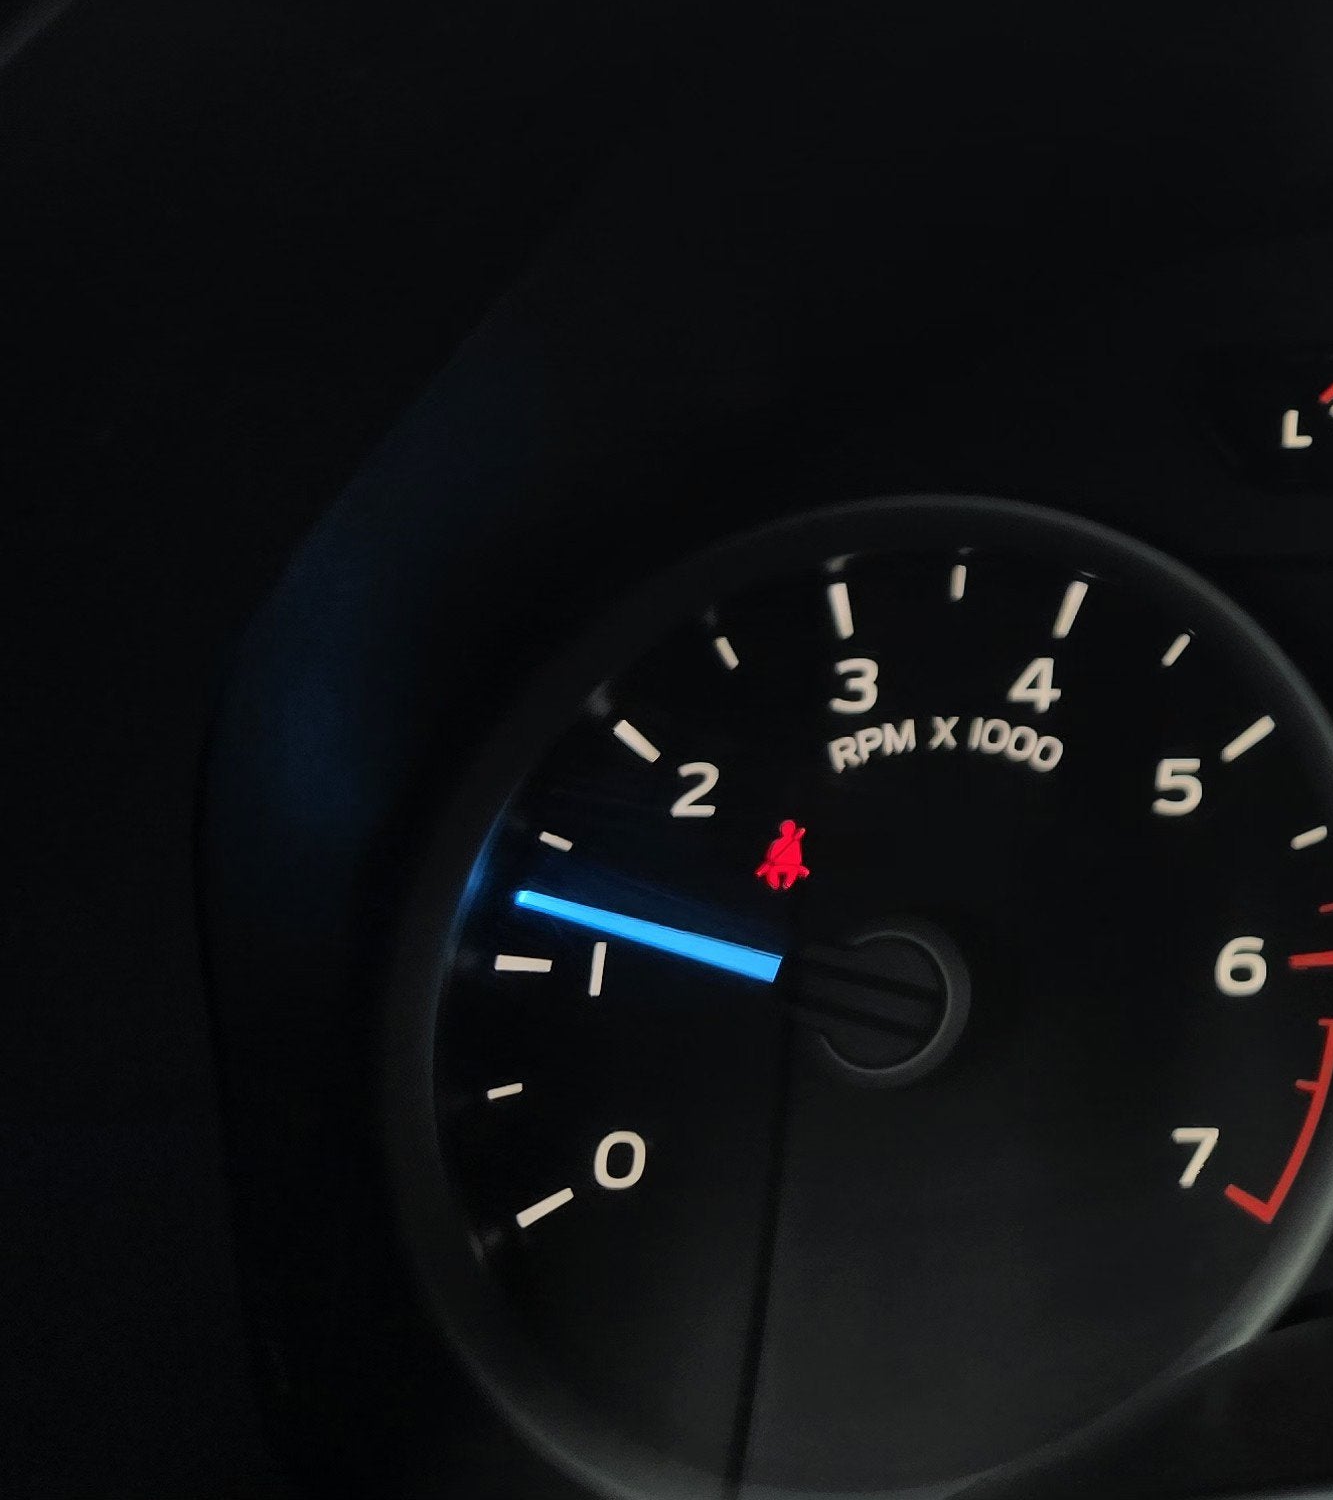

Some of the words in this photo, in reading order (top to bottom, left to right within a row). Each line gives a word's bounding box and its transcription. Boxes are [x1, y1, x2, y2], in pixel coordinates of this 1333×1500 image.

[1282, 409, 1313, 449] L
[829, 657, 879, 714] 3
[1008, 657, 1062, 713] 4
[828, 717, 917, 773] RPM
[929, 716, 960, 750] X
[967, 716, 1064, 772] 1000
[669, 761, 720, 817] 2
[1152, 758, 1203, 816] 5
[588, 941, 608, 997] 1
[1214, 936, 1267, 996] 6
[593, 1130, 647, 1191] 0
[1170, 1127, 1220, 1190] 7
